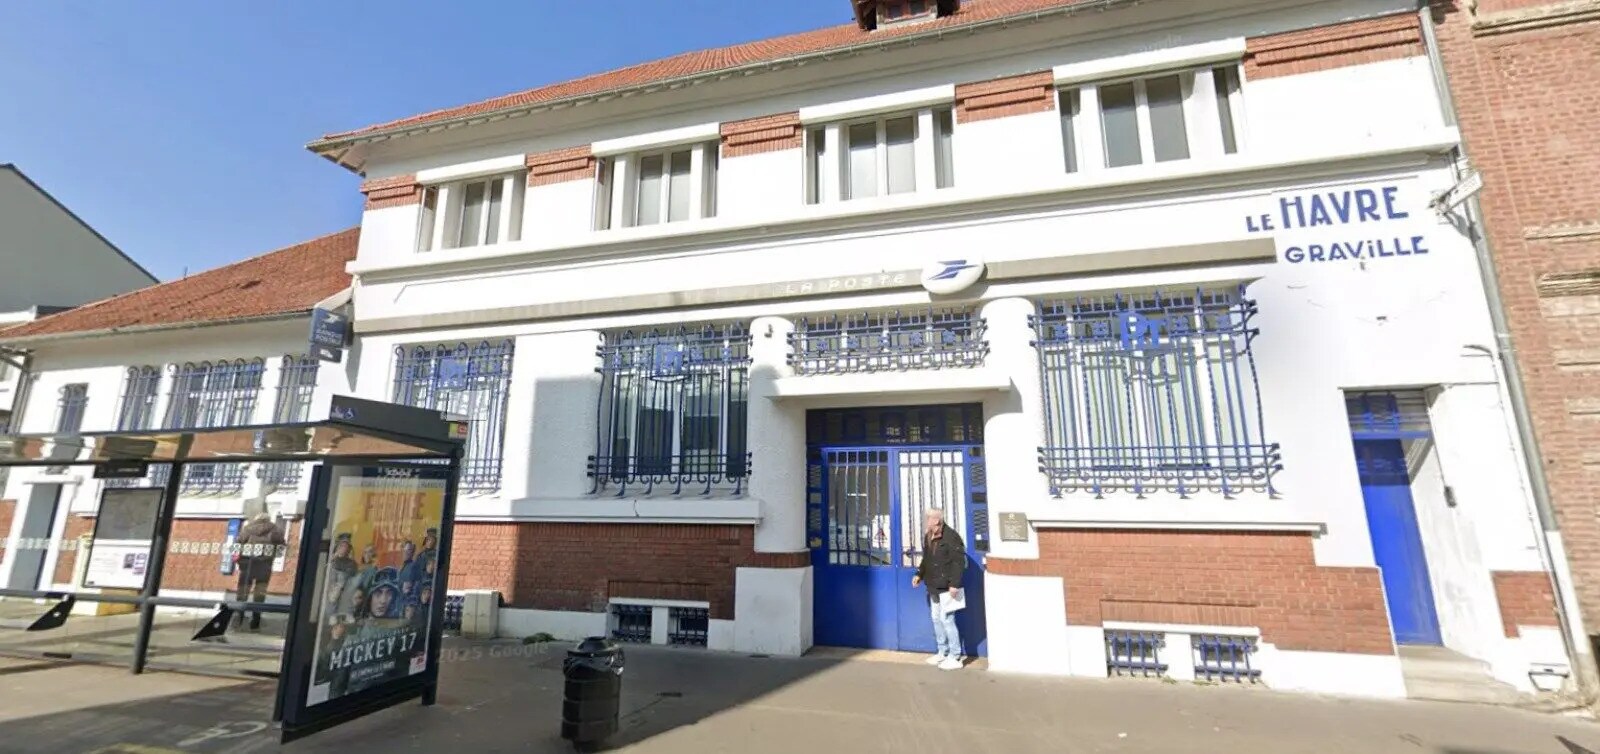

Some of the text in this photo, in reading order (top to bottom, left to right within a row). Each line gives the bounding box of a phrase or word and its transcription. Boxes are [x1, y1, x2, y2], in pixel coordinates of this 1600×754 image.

[1245, 186, 1409, 233] LE HAVRE
[329, 636, 397, 672] MICKEY
[400, 631, 417, 653] 17
